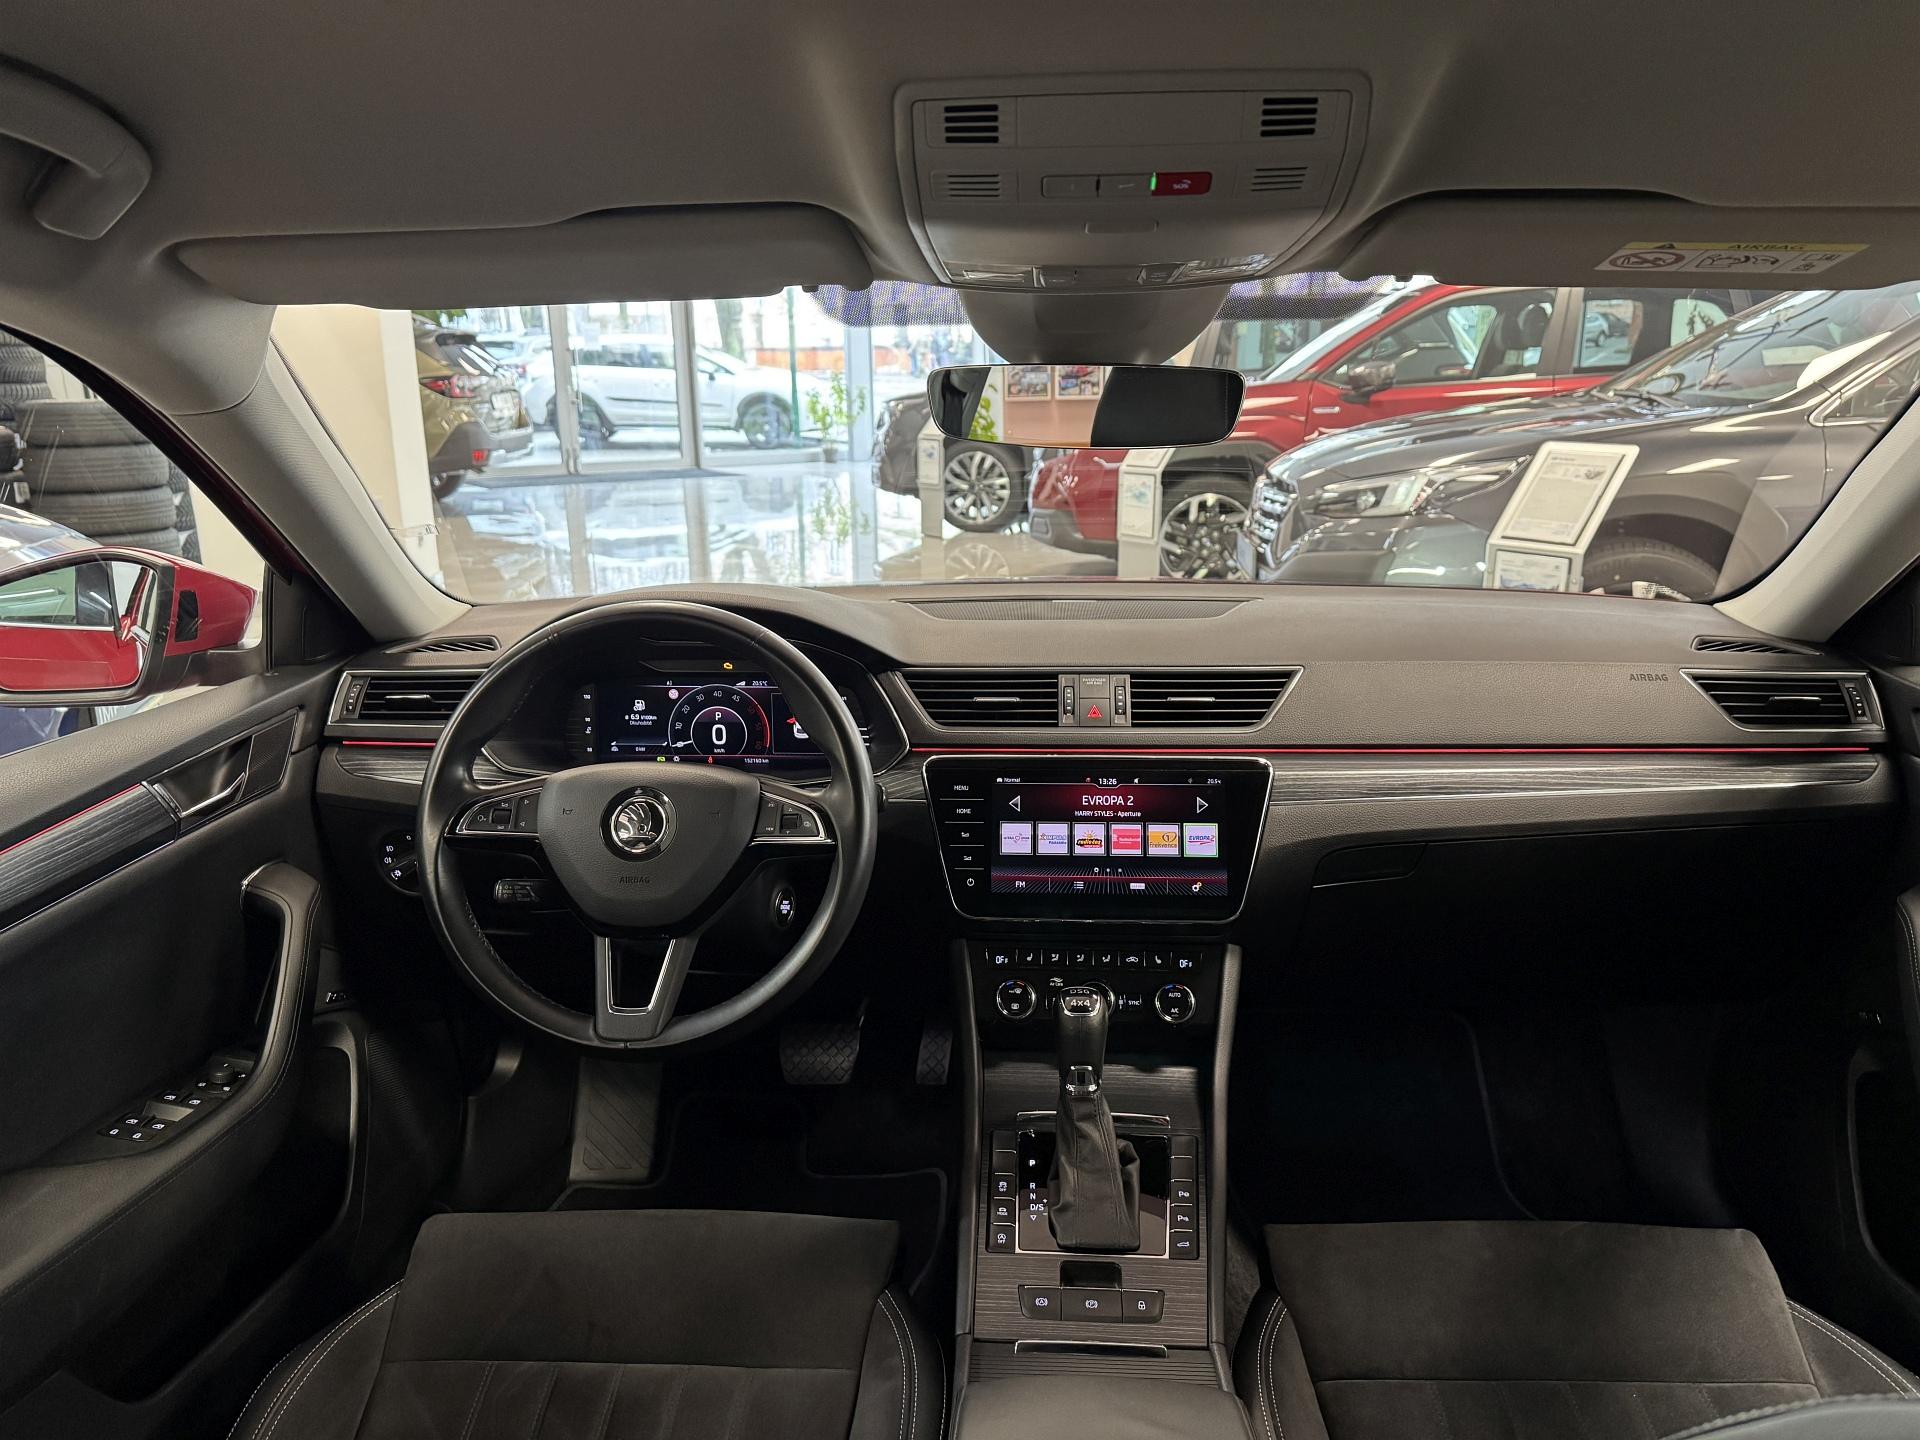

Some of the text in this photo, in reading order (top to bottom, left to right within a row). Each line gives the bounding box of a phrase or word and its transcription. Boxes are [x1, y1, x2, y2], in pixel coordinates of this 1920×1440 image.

[1728, 242, 1804, 250] AIRBAG
[1630, 673, 1668, 682] AIRBAG
[696, 693, 705, 702] 30
[732, 694, 741, 702] 45
[681, 705, 691, 714] 20
[715, 712, 722, 720] P
[712, 724, 726, 745] 0
[1082, 796, 1134, 806] EVROPA 2
[619, 876, 650, 884] AIRBAG
